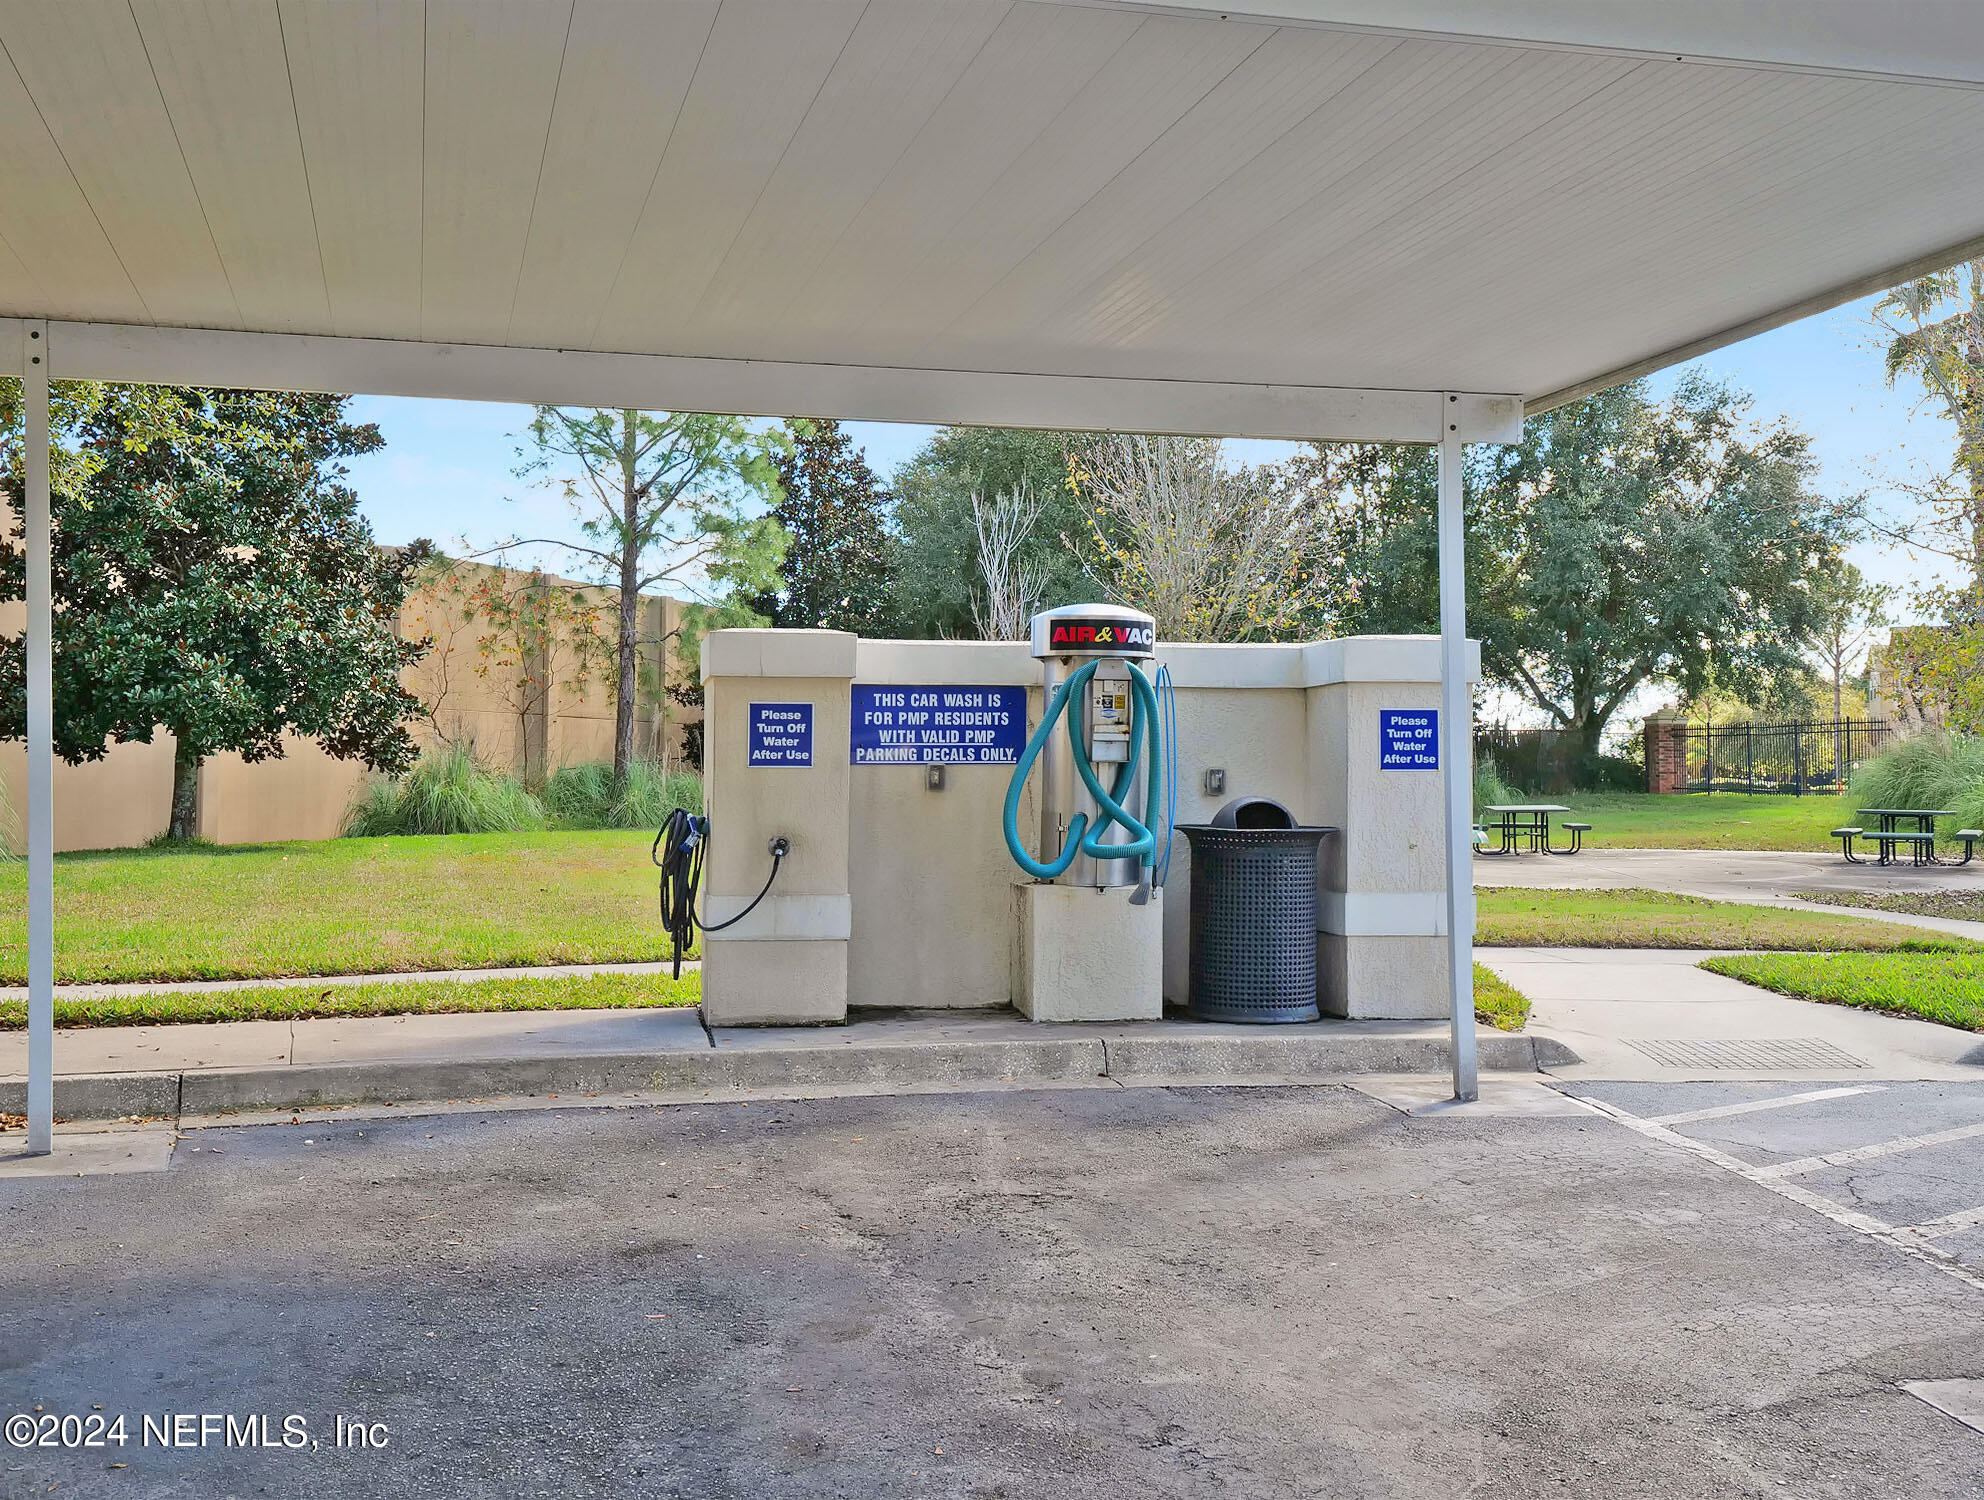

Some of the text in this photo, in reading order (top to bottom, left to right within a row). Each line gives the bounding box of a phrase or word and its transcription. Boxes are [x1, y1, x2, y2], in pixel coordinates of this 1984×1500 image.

[874, 693, 1002, 708] THIS CAR WASH IS
[761, 709, 802, 722] Please
[864, 711, 1010, 727] FOR PMP RESIDENTS
[1390, 716, 1428, 726] Please
[756, 723, 806, 734] Turn Off
[1386, 728, 1433, 738] Turn Off
[762, 736, 800, 748] Water
[879, 729, 996, 744] WITH VALID PMP
[1392, 741, 1427, 751] Water
[752, 749, 810, 760] After Use
[855, 747, 1018, 763] PARKING DECALS ONLY.
[1383, 754, 1437, 764] After Use
